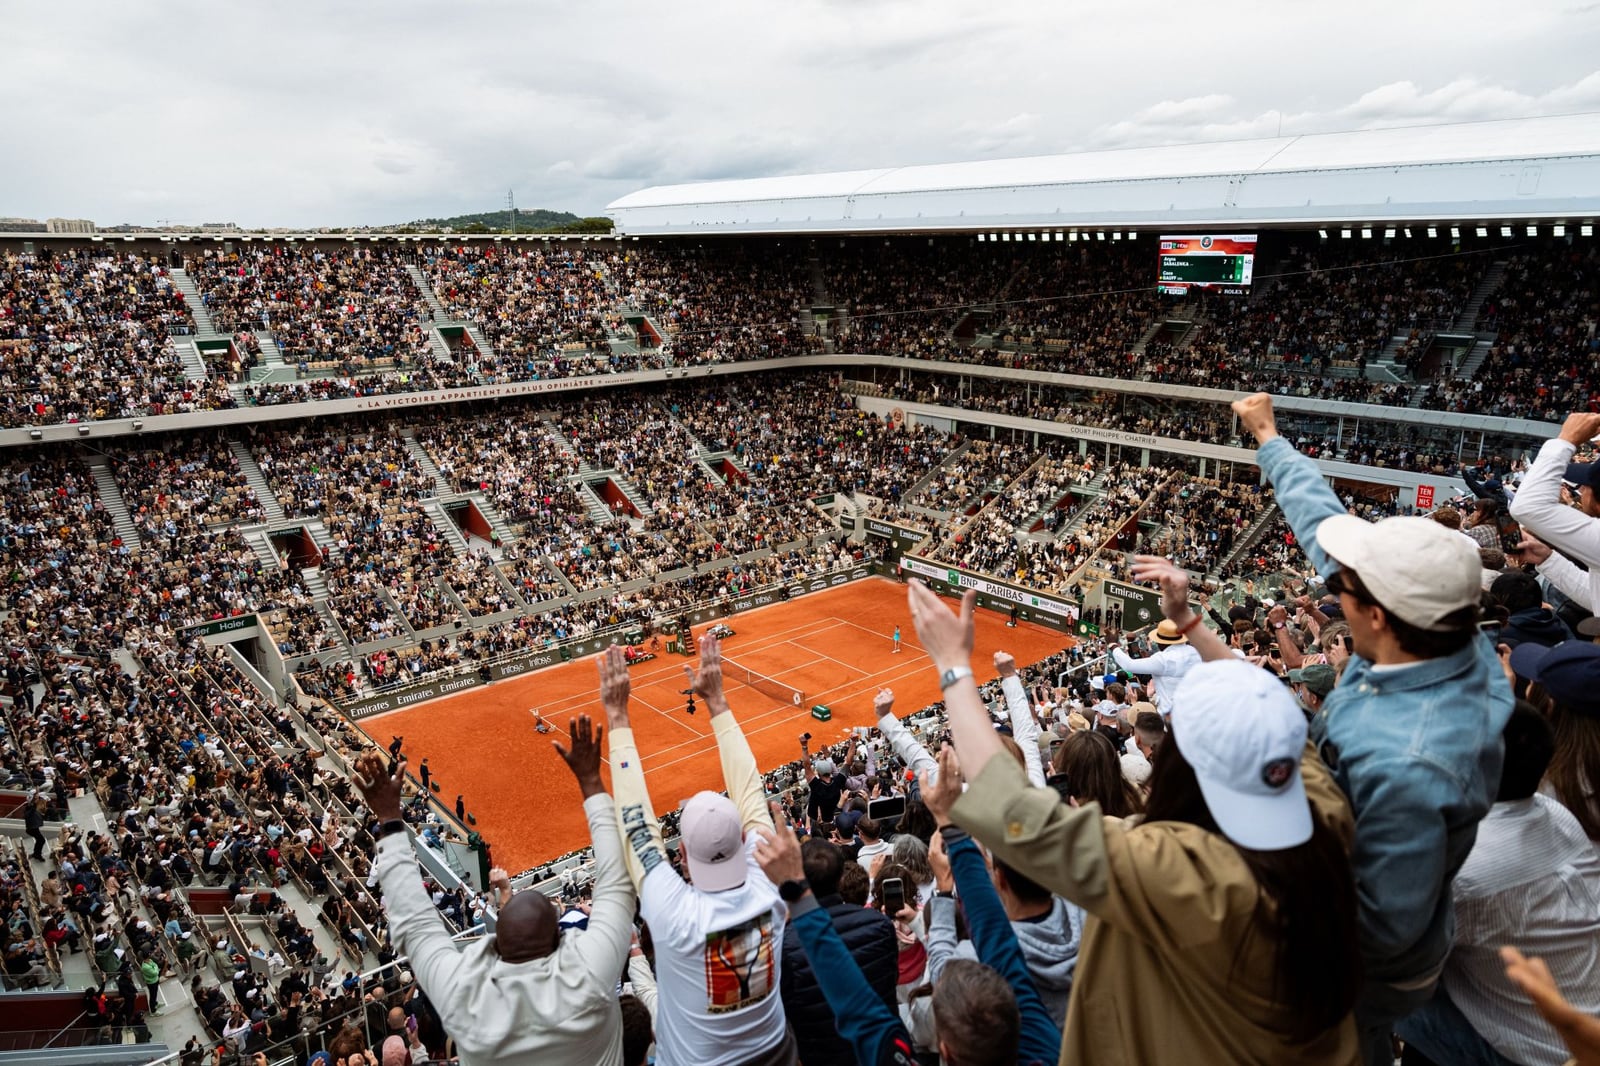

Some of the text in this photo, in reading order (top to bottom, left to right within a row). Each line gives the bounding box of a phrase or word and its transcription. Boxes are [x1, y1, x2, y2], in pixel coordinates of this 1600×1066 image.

[385, 396, 435, 406] VICTOIRE
[441, 389, 501, 401] APPARTIENT
[522, 384, 543, 392] PLUS
[547, 379, 594, 390] OPINIÂTRE
[1070, 427, 1090, 435] COURT
[1092, 431, 1120, 440] PHILIPPE
[1124, 434, 1157, 445] CHATRIER
[1419, 487, 1432, 495] TEN
[1418, 498, 1430, 506] NIS
[870, 521, 893, 534] Emirates
[899, 529, 923, 541] Emirates
[960, 575, 1024, 602] BNP PARIBAS
[1109, 584, 1144, 601] Emirates
[219, 620, 245, 631] Haier
[528, 655, 552, 668] Infosys
[500, 663, 525, 675] Infosys
[440, 677, 476, 693] Emirates
[396, 688, 434, 705] Emirates
[350, 701, 390, 717] Emirates
